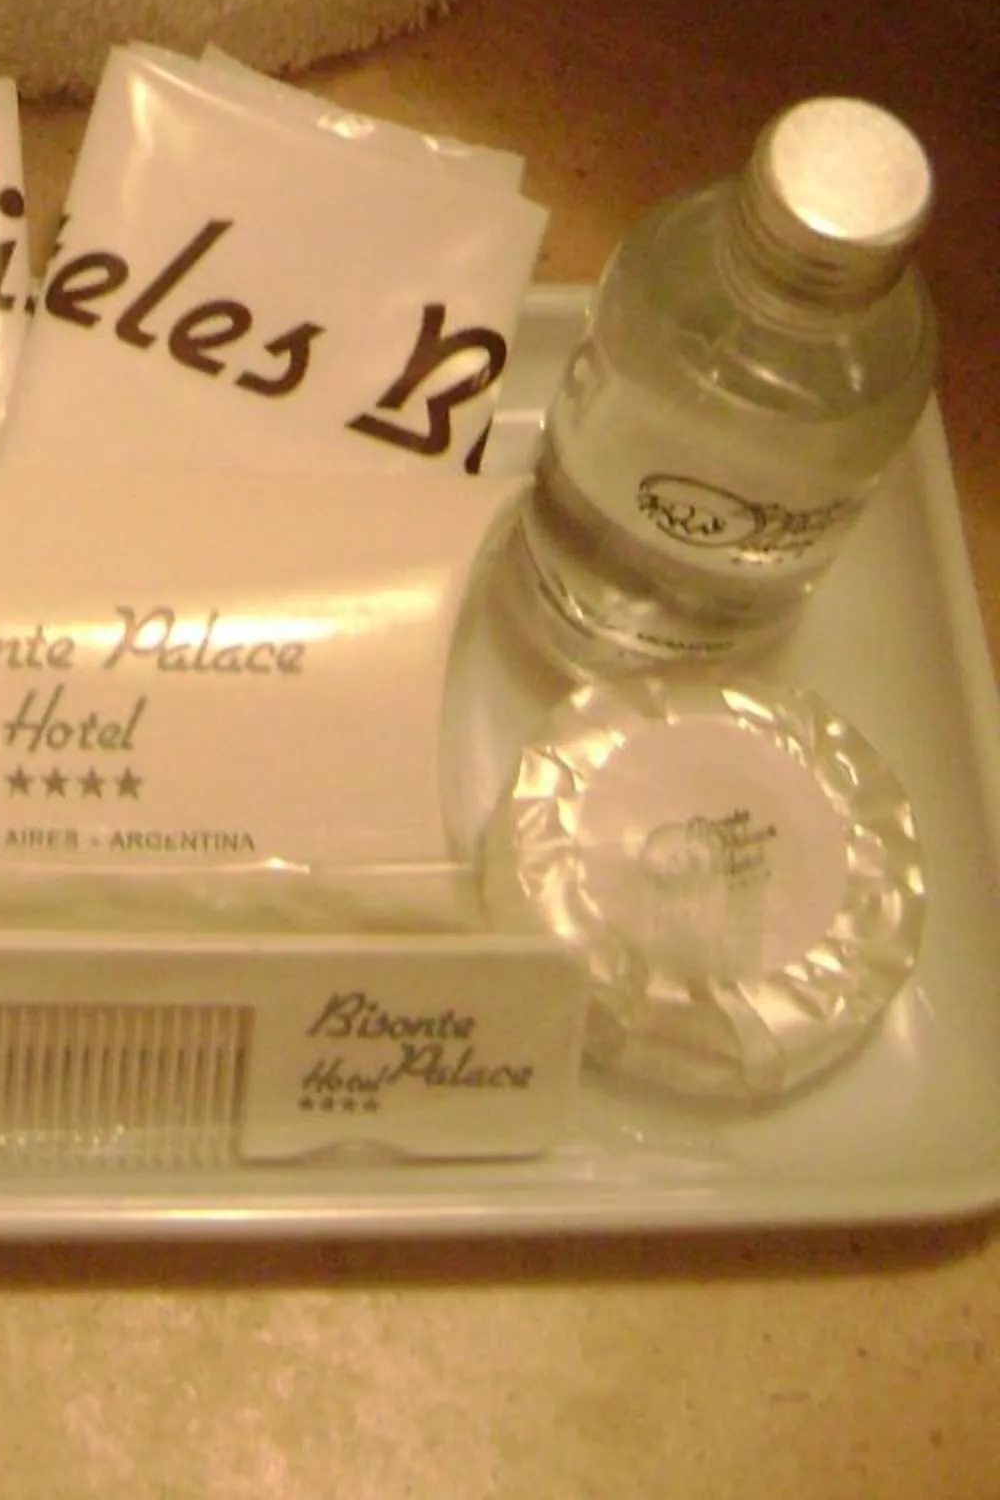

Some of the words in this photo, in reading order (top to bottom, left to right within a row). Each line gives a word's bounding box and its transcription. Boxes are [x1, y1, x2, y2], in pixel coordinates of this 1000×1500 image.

[103, 604, 307, 675] Palace
[4, 682, 150, 754] Hotel
[3, 826, 79, 851] AIRES
[107, 828, 257, 854] ARGENTINA
[306, 990, 477, 1040] Bisonte
[385, 1040, 535, 1089] Palace
